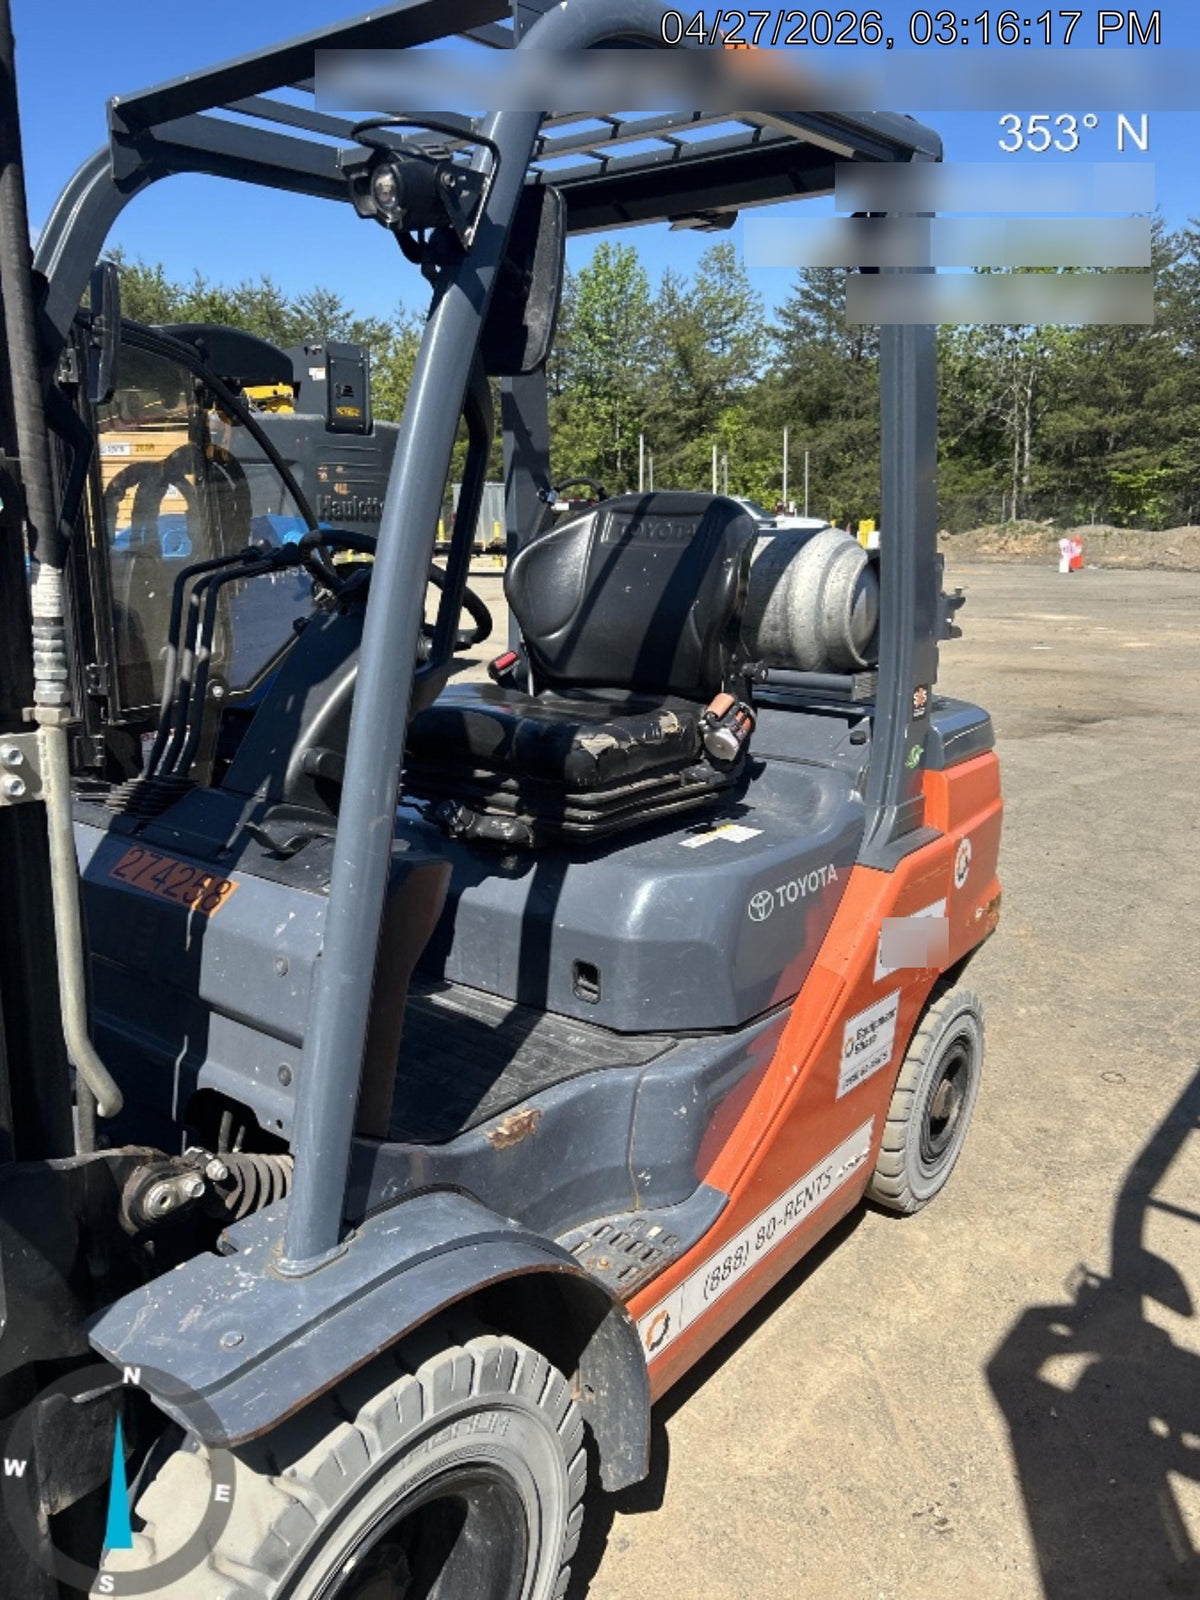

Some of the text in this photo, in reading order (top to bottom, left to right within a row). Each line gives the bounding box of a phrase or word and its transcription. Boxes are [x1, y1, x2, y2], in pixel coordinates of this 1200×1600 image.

[112, 848, 232, 911] 274258
[775, 863, 838, 908] TOYOTA
[703, 1165, 833, 1301] (888) 80-RENTS
